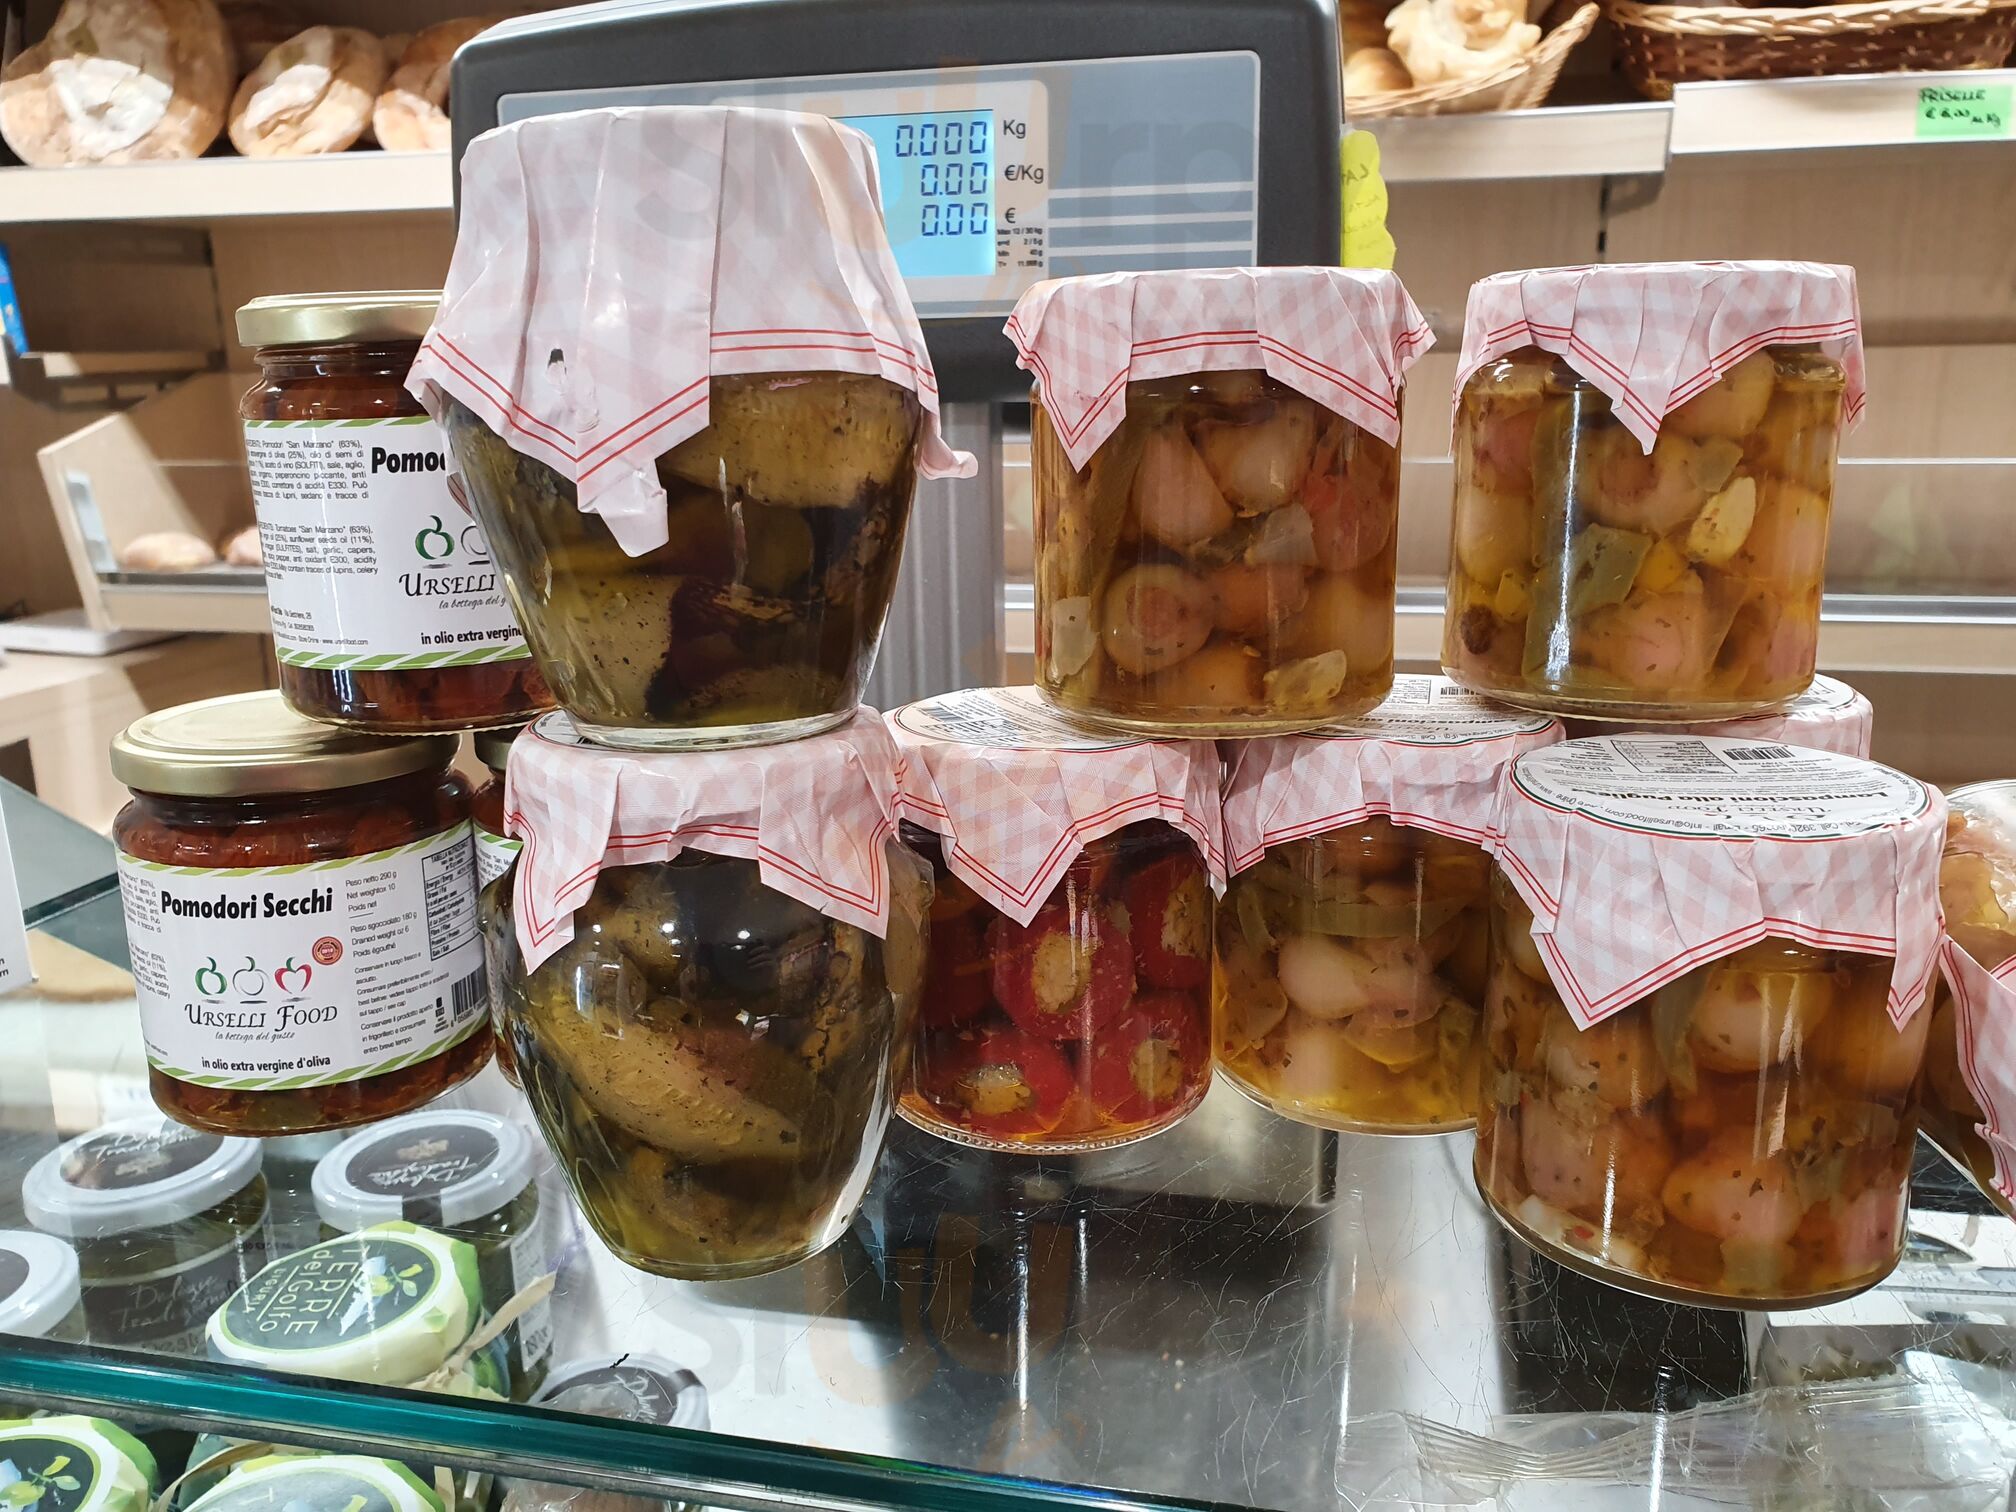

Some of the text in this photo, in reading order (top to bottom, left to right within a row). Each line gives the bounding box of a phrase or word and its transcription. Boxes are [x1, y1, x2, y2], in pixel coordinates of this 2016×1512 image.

[1003, 119, 1026, 139] Kg
[896, 121, 987, 157] 0.000
[921, 162, 987, 196] 0.00
[1004, 164, 1044, 184] €/Kg
[922, 202, 988, 236] 0.00
[1005, 207, 1016, 224] €
[335, 451, 352, 459] semi
[352, 471, 367, 479] anti
[352, 480, 368, 489] Può
[399, 573, 496, 597] URSELLI
[438, 599, 449, 609] la
[450, 597, 484, 612] bottega
[421, 632, 431, 645] in
[435, 631, 454, 644] olio
[457, 629, 484, 643] extra
[1604, 807, 1702, 830] info@ursellifood.com
[345, 879, 362, 887] Peso
[161, 887, 333, 919] Pomodori Secchi
[348, 903, 366, 912] Poids
[350, 925, 367, 933] Peso
[353, 949, 371, 958] Poids
[184, 1004, 338, 1032] URSELLI FOOD
[215, 1031, 224, 1040] la
[201, 1056, 331, 1074] in olio extra vergine d'oliva
